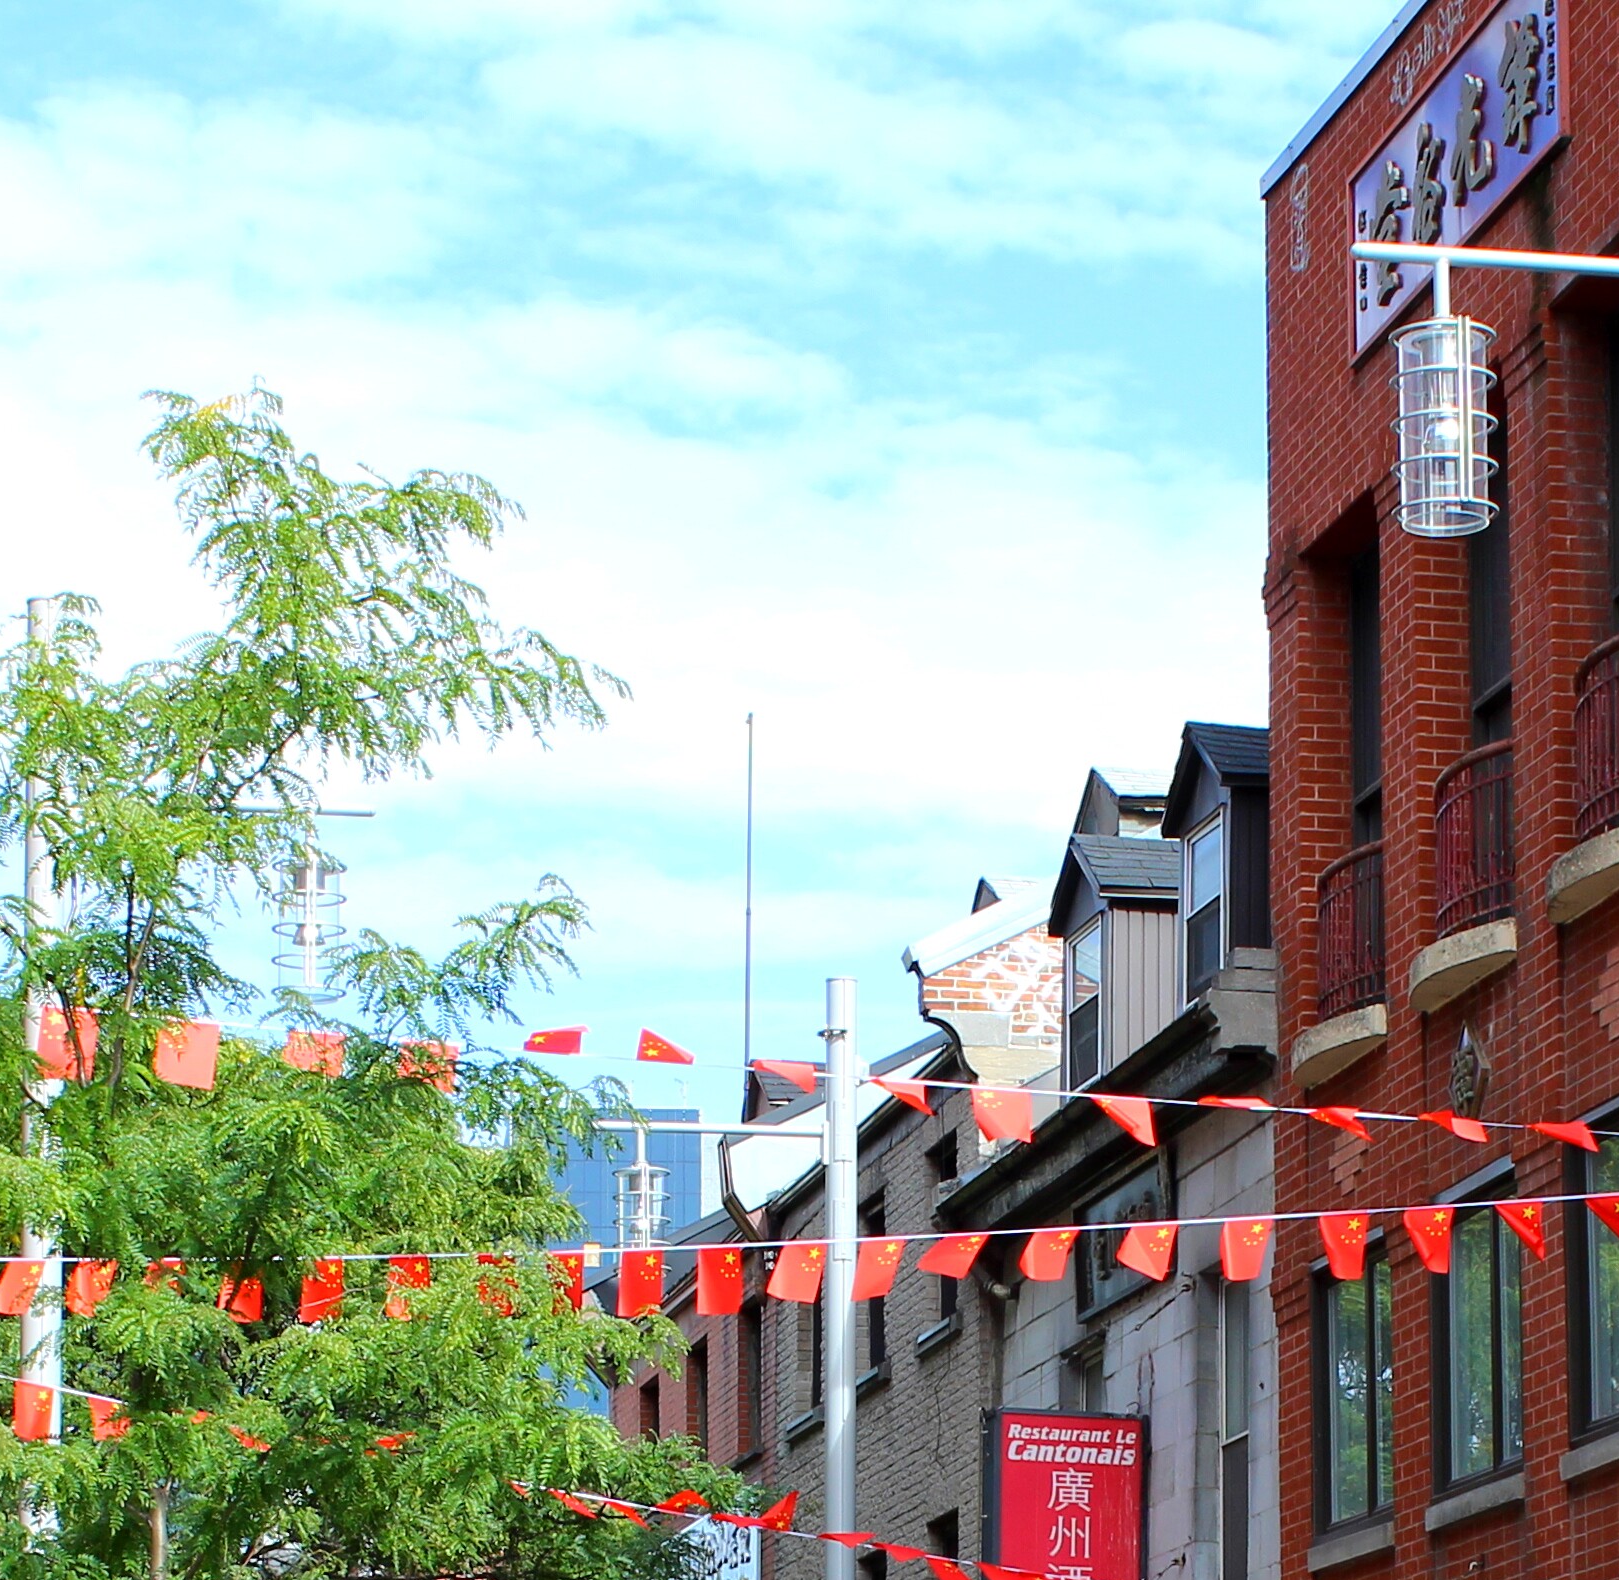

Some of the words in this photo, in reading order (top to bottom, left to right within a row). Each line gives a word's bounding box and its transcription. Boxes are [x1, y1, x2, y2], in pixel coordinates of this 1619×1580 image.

[1008, 1423, 1111, 1443] Restaurant
[1115, 1429, 1136, 1444] Le
[1008, 1439, 1136, 1467] Cantonais
